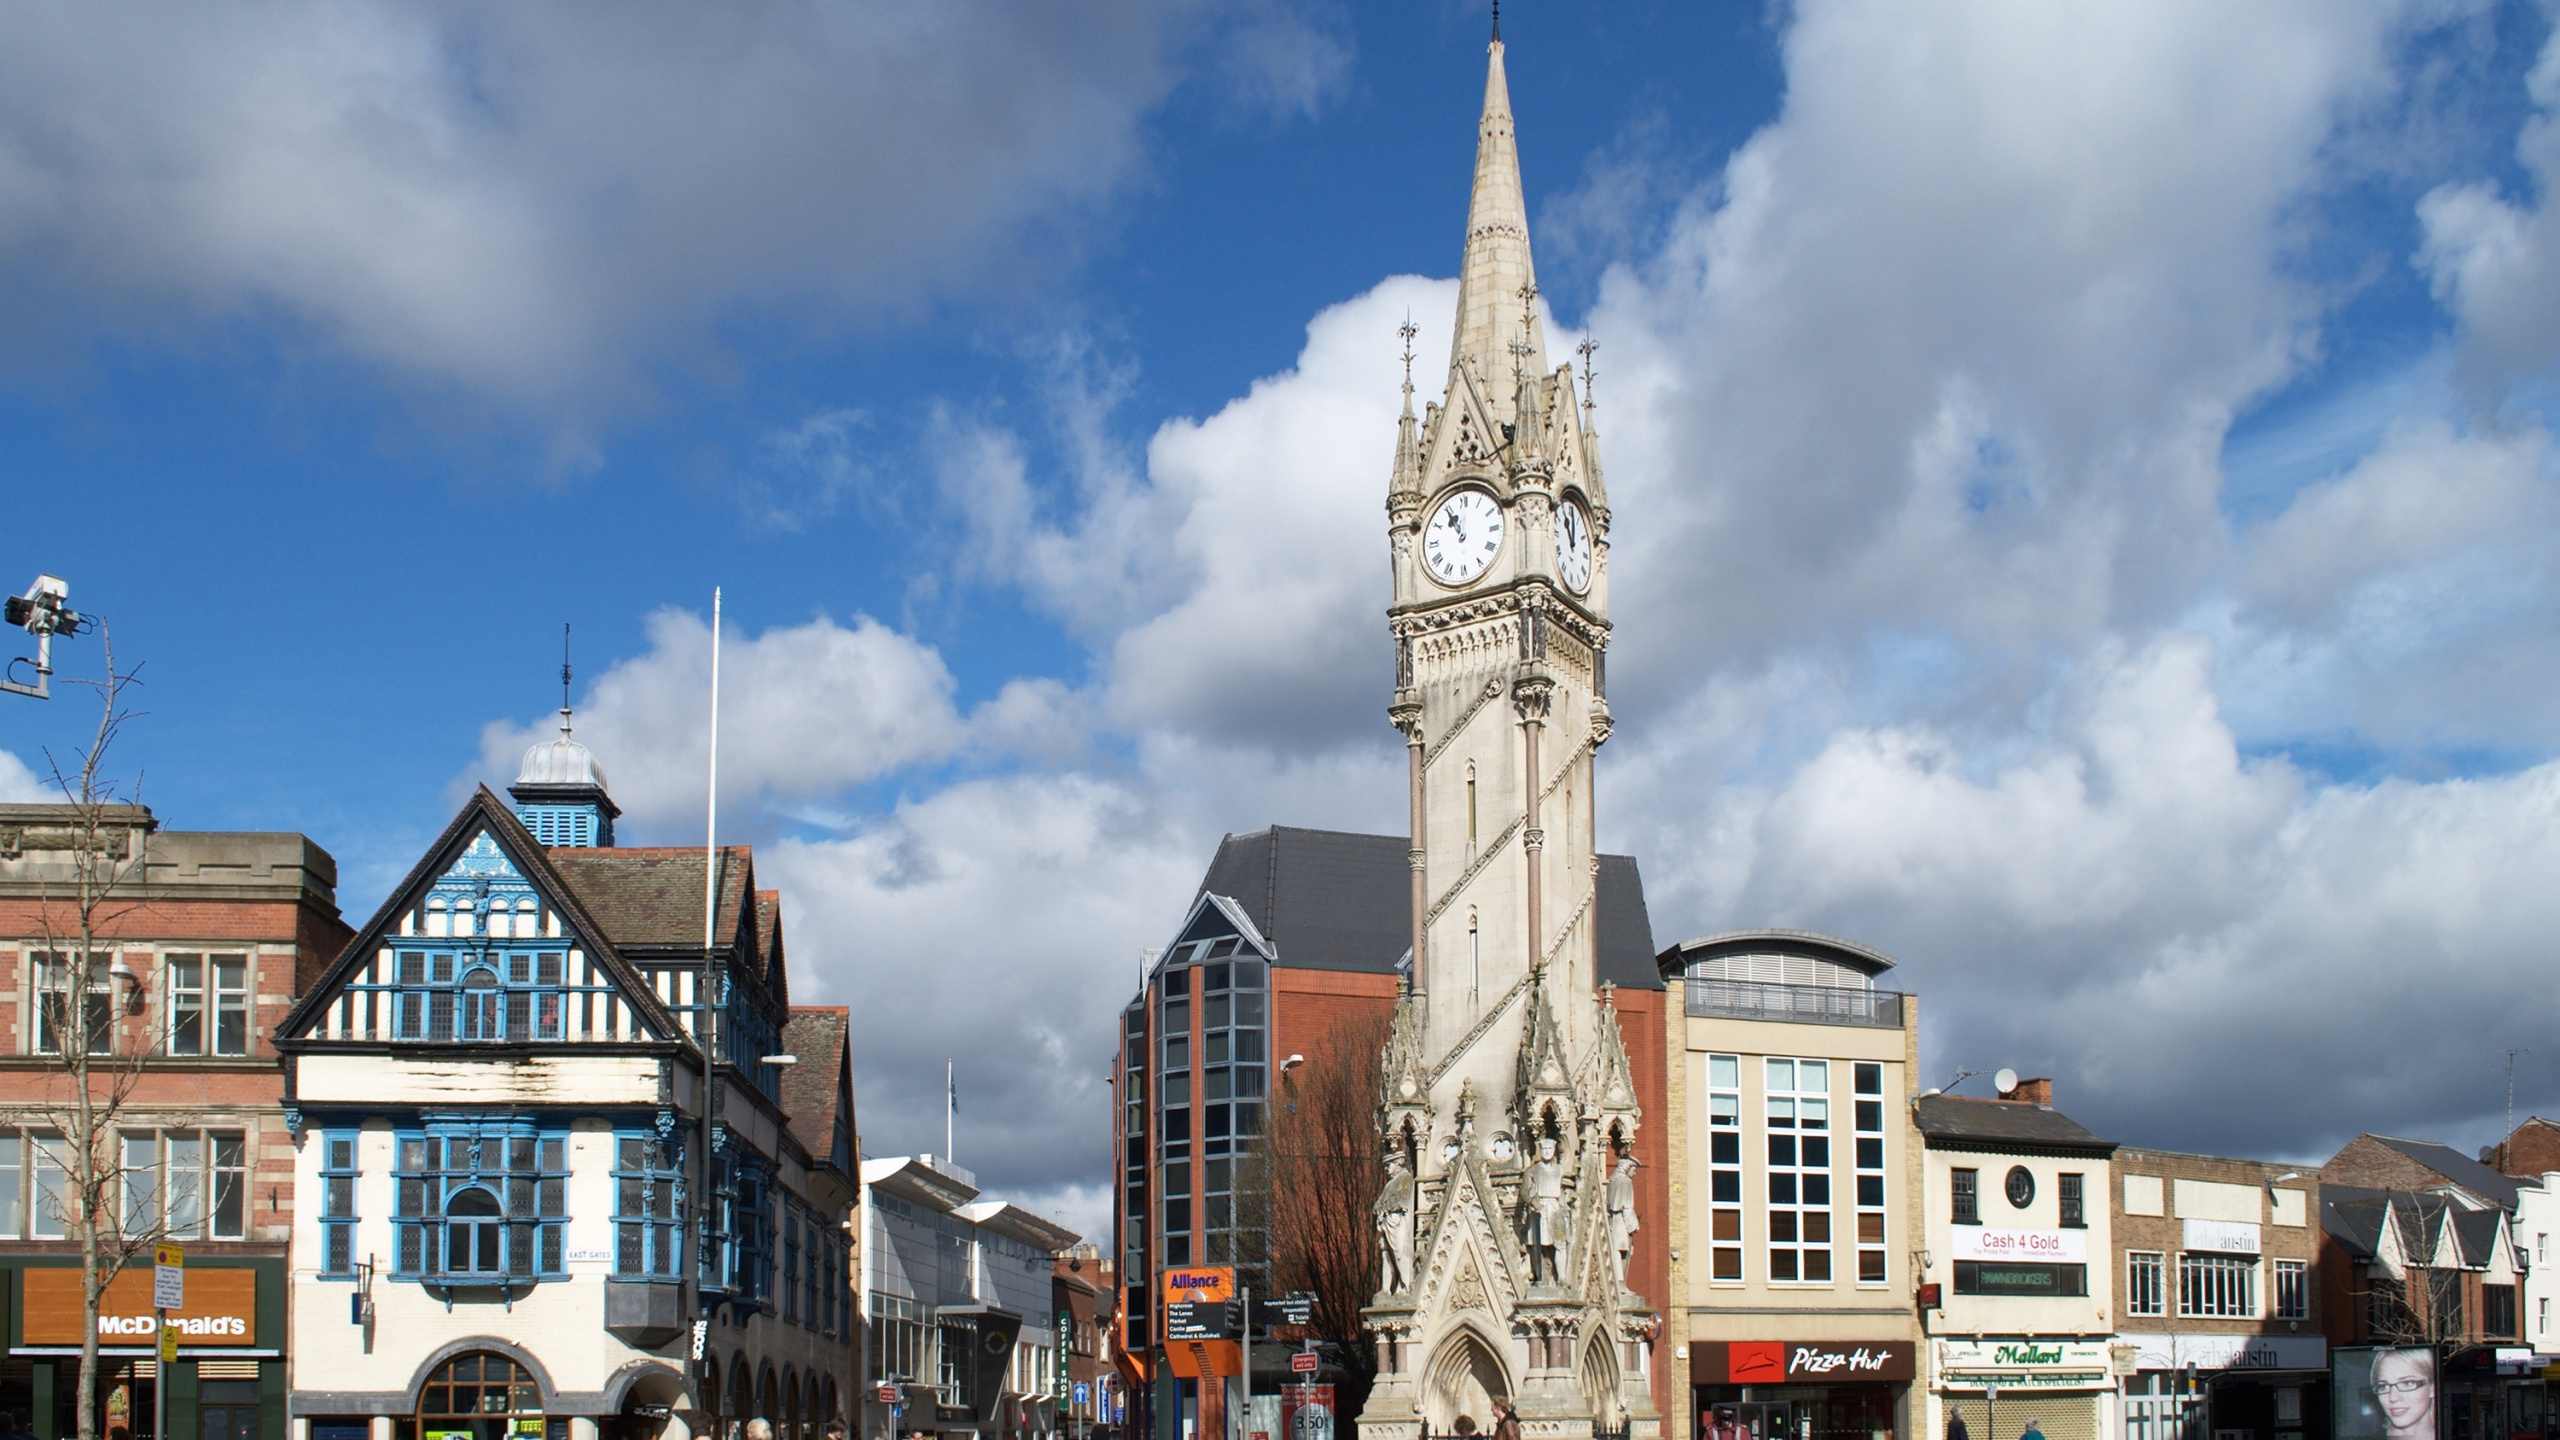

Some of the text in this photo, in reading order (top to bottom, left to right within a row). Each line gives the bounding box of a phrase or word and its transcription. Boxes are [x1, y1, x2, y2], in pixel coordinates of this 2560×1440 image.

[1982, 1233, 2059, 1250] Cash 4 Gold
[1170, 1274, 1220, 1290] Alliance
[98, 1316, 246, 1335] McDnald's
[1789, 1348, 1892, 1374] Pizza Hut
[1994, 1345, 2063, 1364] Mallard
